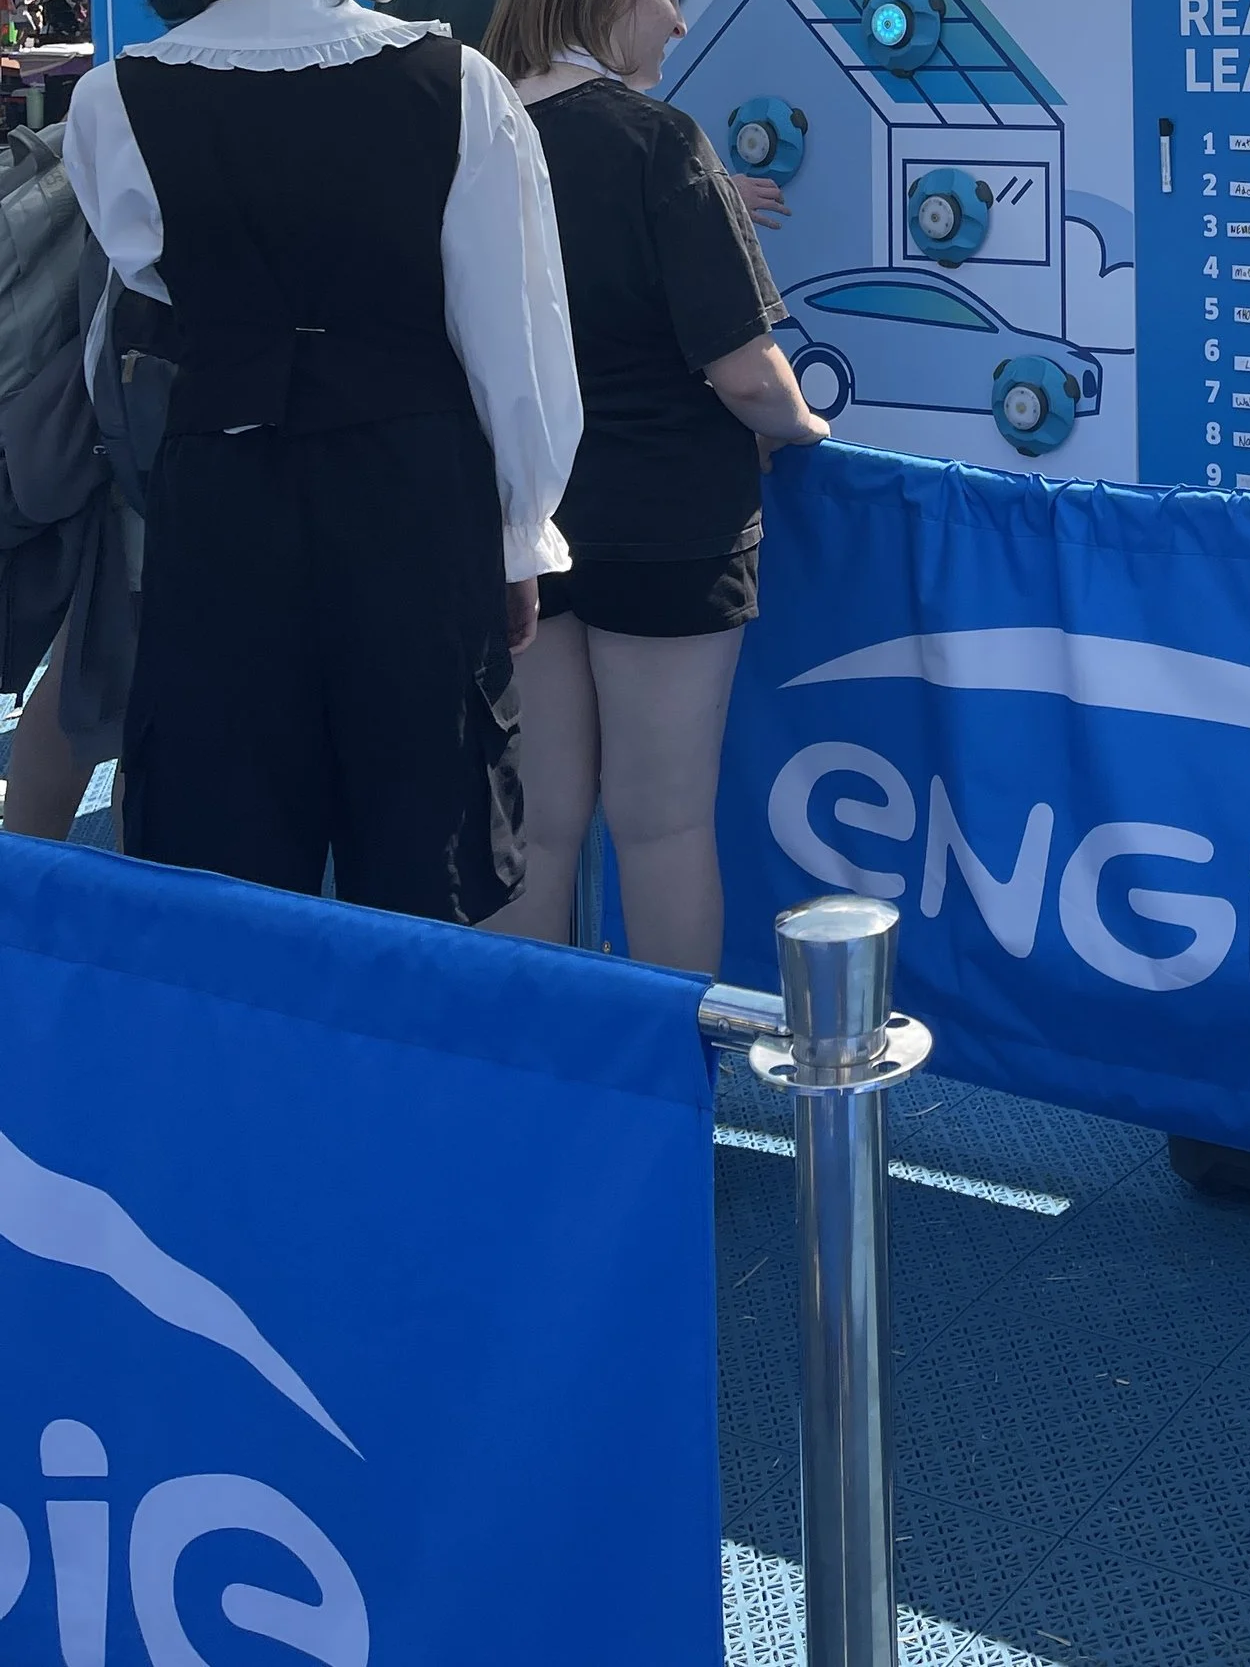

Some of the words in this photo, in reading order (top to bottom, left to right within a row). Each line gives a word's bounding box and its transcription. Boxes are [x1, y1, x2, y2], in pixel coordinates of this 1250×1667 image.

[1203, 132, 1216, 155] 1
[1202, 173, 1217, 196] 2
[1203, 214, 1218, 237] 3
[1203, 255, 1219, 279] 4
[1204, 297, 1219, 321] 5
[1204, 338, 1220, 362] 6
[1205, 379, 1220, 403] 7
[1206, 421, 1221, 445] 8
[1206, 463, 1222, 487] 9
